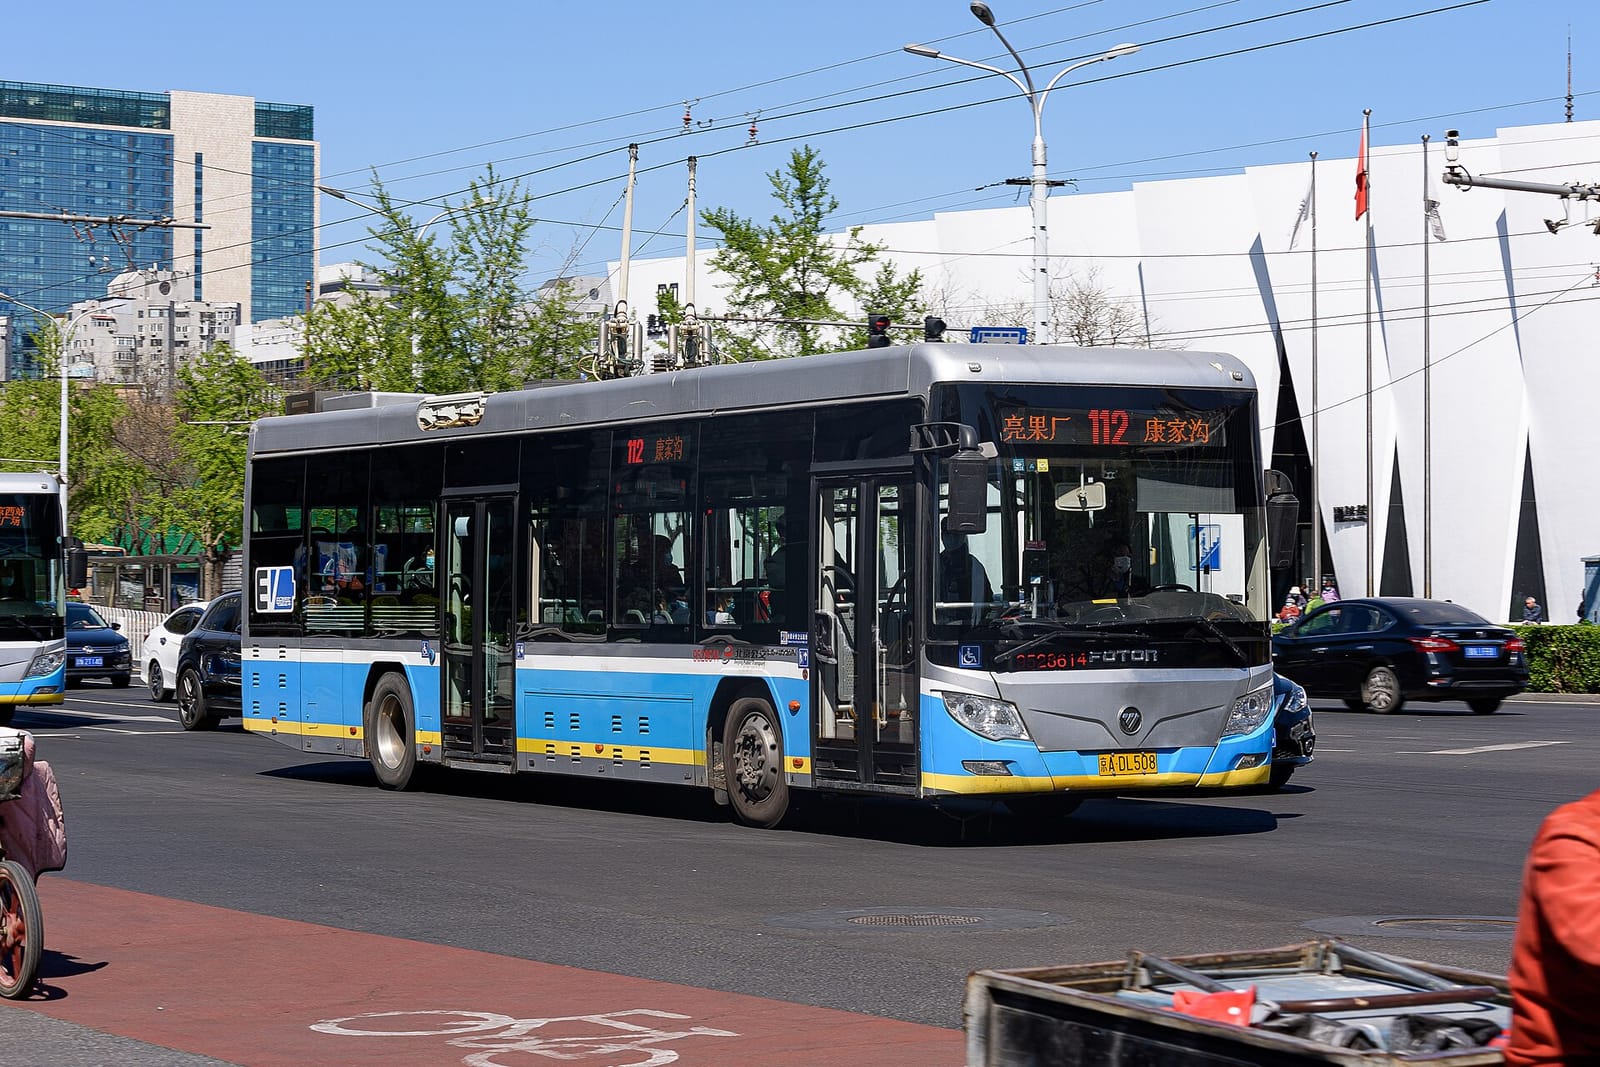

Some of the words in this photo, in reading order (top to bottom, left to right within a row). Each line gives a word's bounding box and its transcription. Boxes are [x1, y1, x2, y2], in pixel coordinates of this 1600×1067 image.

[1002, 413, 1072, 442] 亮果厂
[1088, 409, 1130, 445] 112
[1143, 416, 1210, 444] 康家沟
[627, 438, 644, 464] 112
[655, 435, 683, 462] 康家沟
[1089, 649, 1158, 663] FOTON
